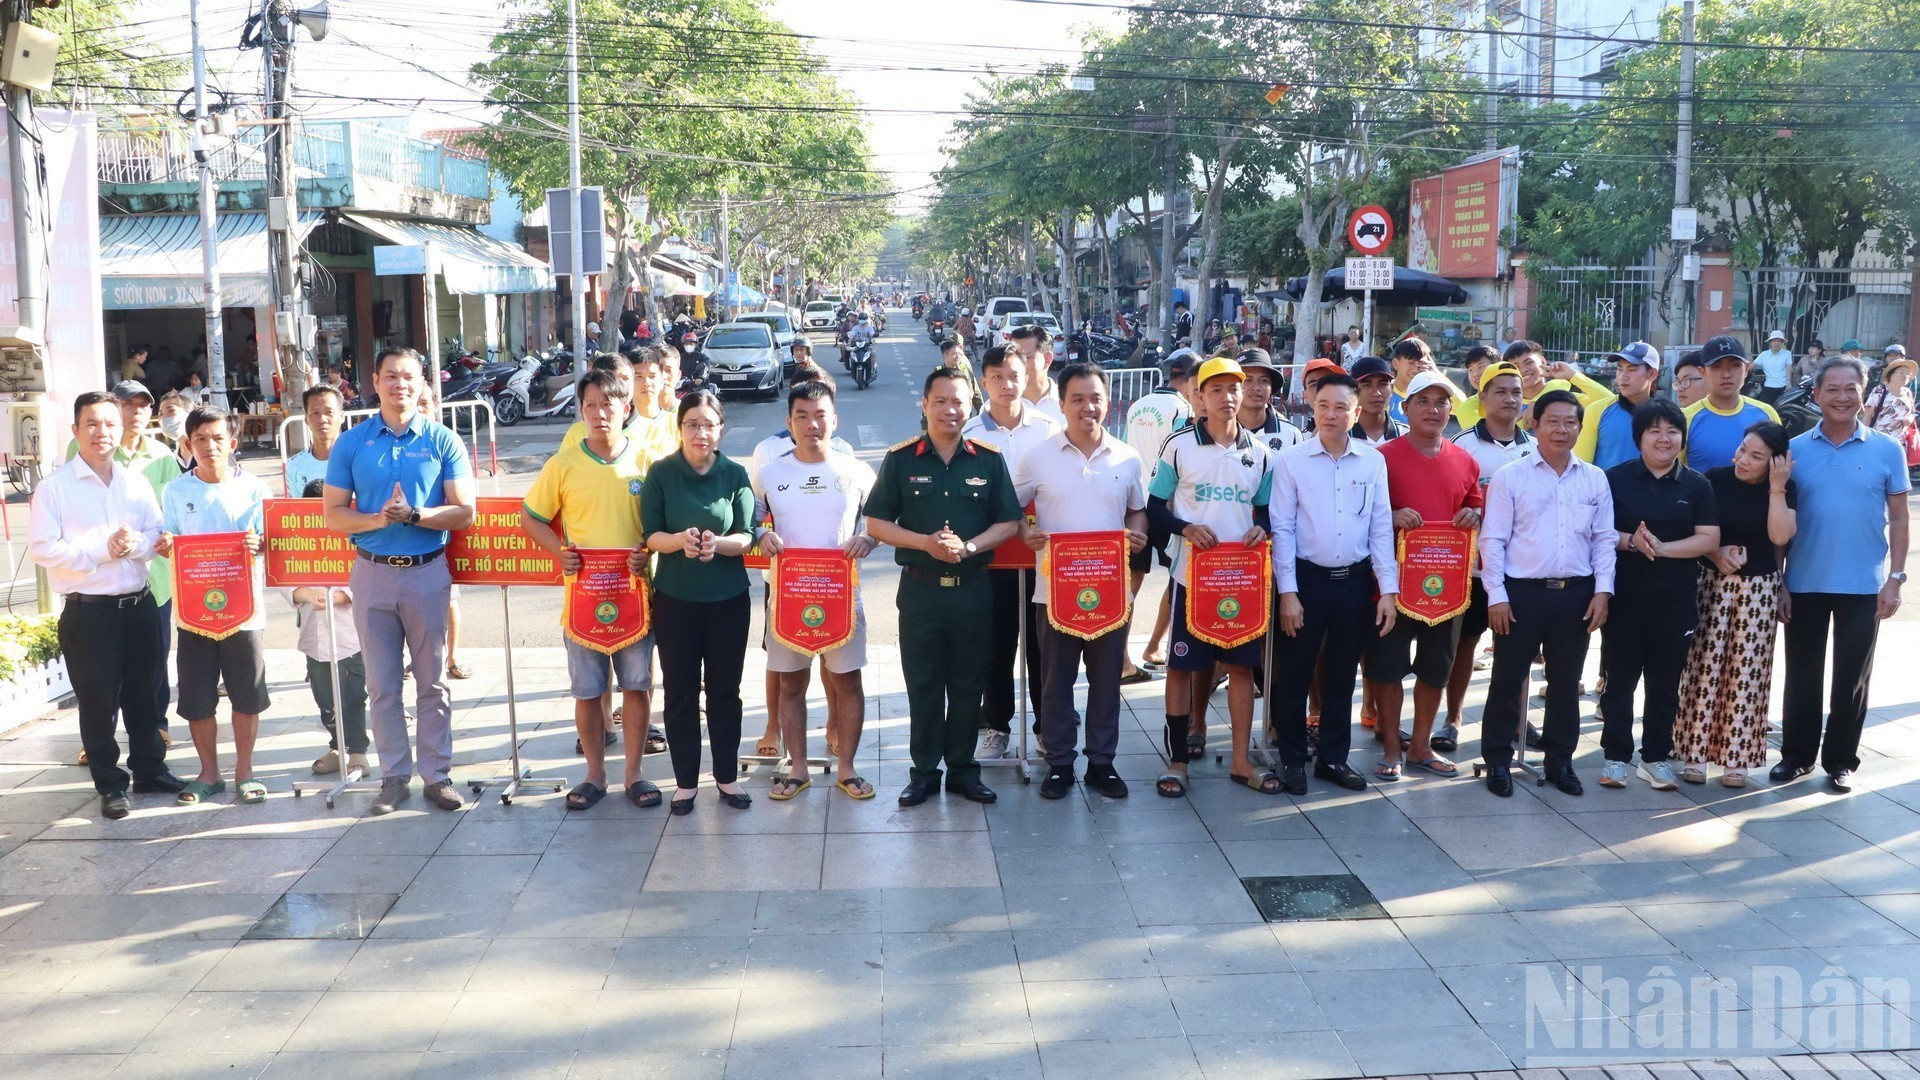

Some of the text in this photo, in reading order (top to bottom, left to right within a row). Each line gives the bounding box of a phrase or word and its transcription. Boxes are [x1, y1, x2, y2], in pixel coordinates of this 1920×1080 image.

[1455, 198, 1469, 208] CÁCH
[1455, 210, 1485, 221] THÁNG TÁM
[1448, 226, 1455, 235] VÀ
[1472, 222, 1490, 233] KHÁNH
[1451, 239, 1461, 248] 2-9
[114, 282, 143, 305] SƯỜN
[145, 286, 166, 304] NON
[281, 512, 300, 532] ĐỘI
[473, 510, 522, 530] ỘI PHƯỜ
[270, 534, 317, 551] PHƯỜNG
[319, 535, 342, 551] TÂN
[465, 533, 489, 549] TÂN
[493, 534, 526, 550] UYÊN
[284, 555, 310, 573] TỈNH
[313, 555, 345, 573] ĐỒNG
[455, 554, 554, 572] TP. HỒ CHÍ MINH
